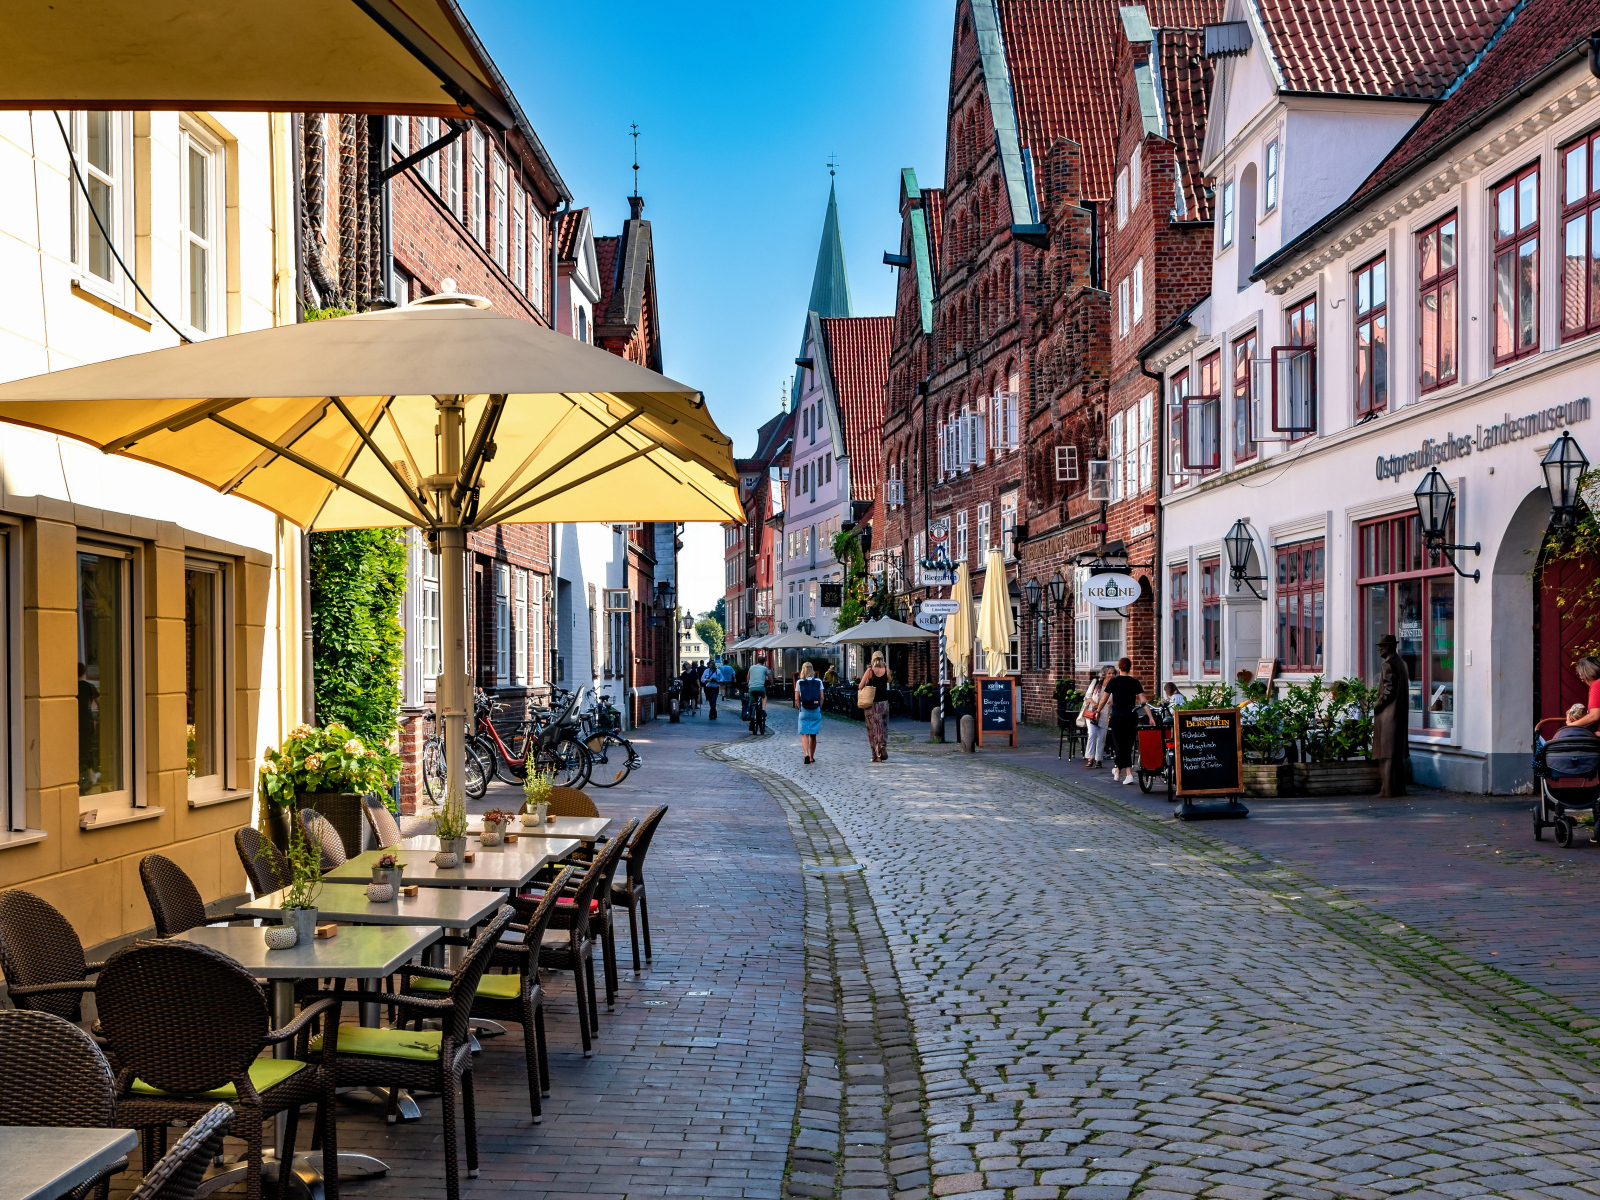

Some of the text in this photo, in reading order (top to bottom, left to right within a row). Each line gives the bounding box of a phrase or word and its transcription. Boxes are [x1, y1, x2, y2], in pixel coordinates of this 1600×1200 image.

[1376, 397, 1591, 483] Ostpreußisches Landesmuseum
[1088, 587, 1135, 597] KRONE
